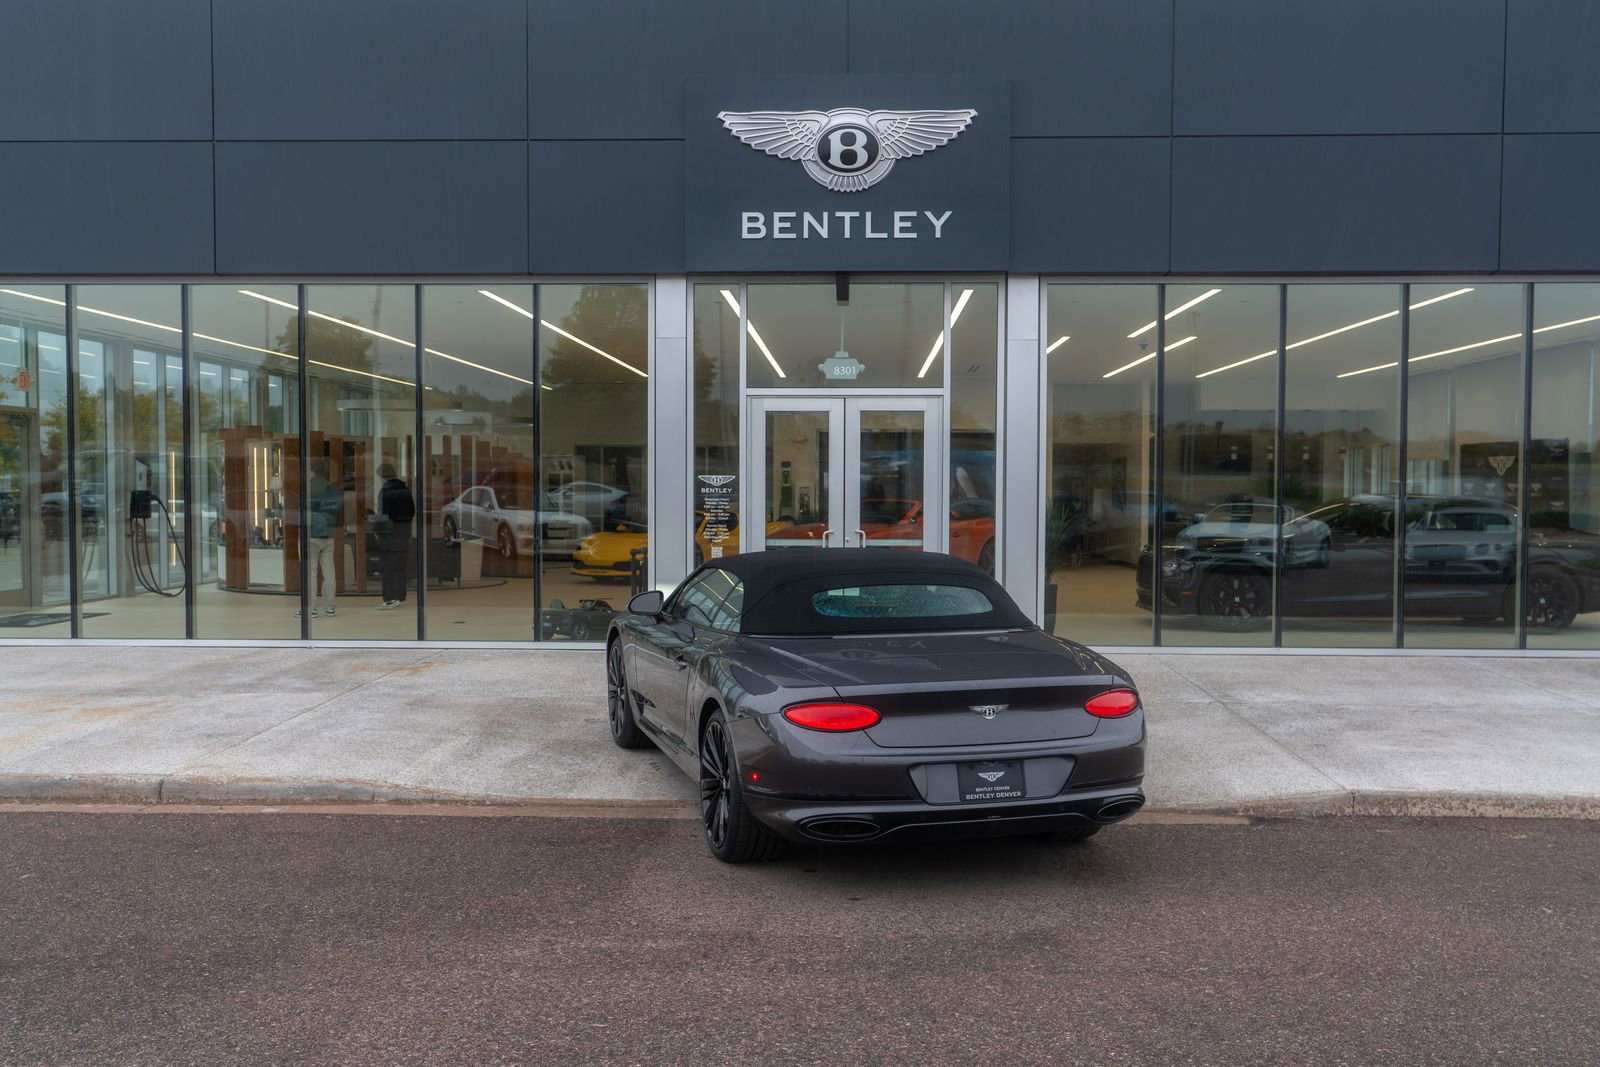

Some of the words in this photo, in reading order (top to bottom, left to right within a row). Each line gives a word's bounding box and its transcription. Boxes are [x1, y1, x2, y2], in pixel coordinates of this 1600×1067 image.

[827, 128, 869, 170] B
[741, 211, 953, 239] BENTLEY
[834, 366, 856, 375] 8301
